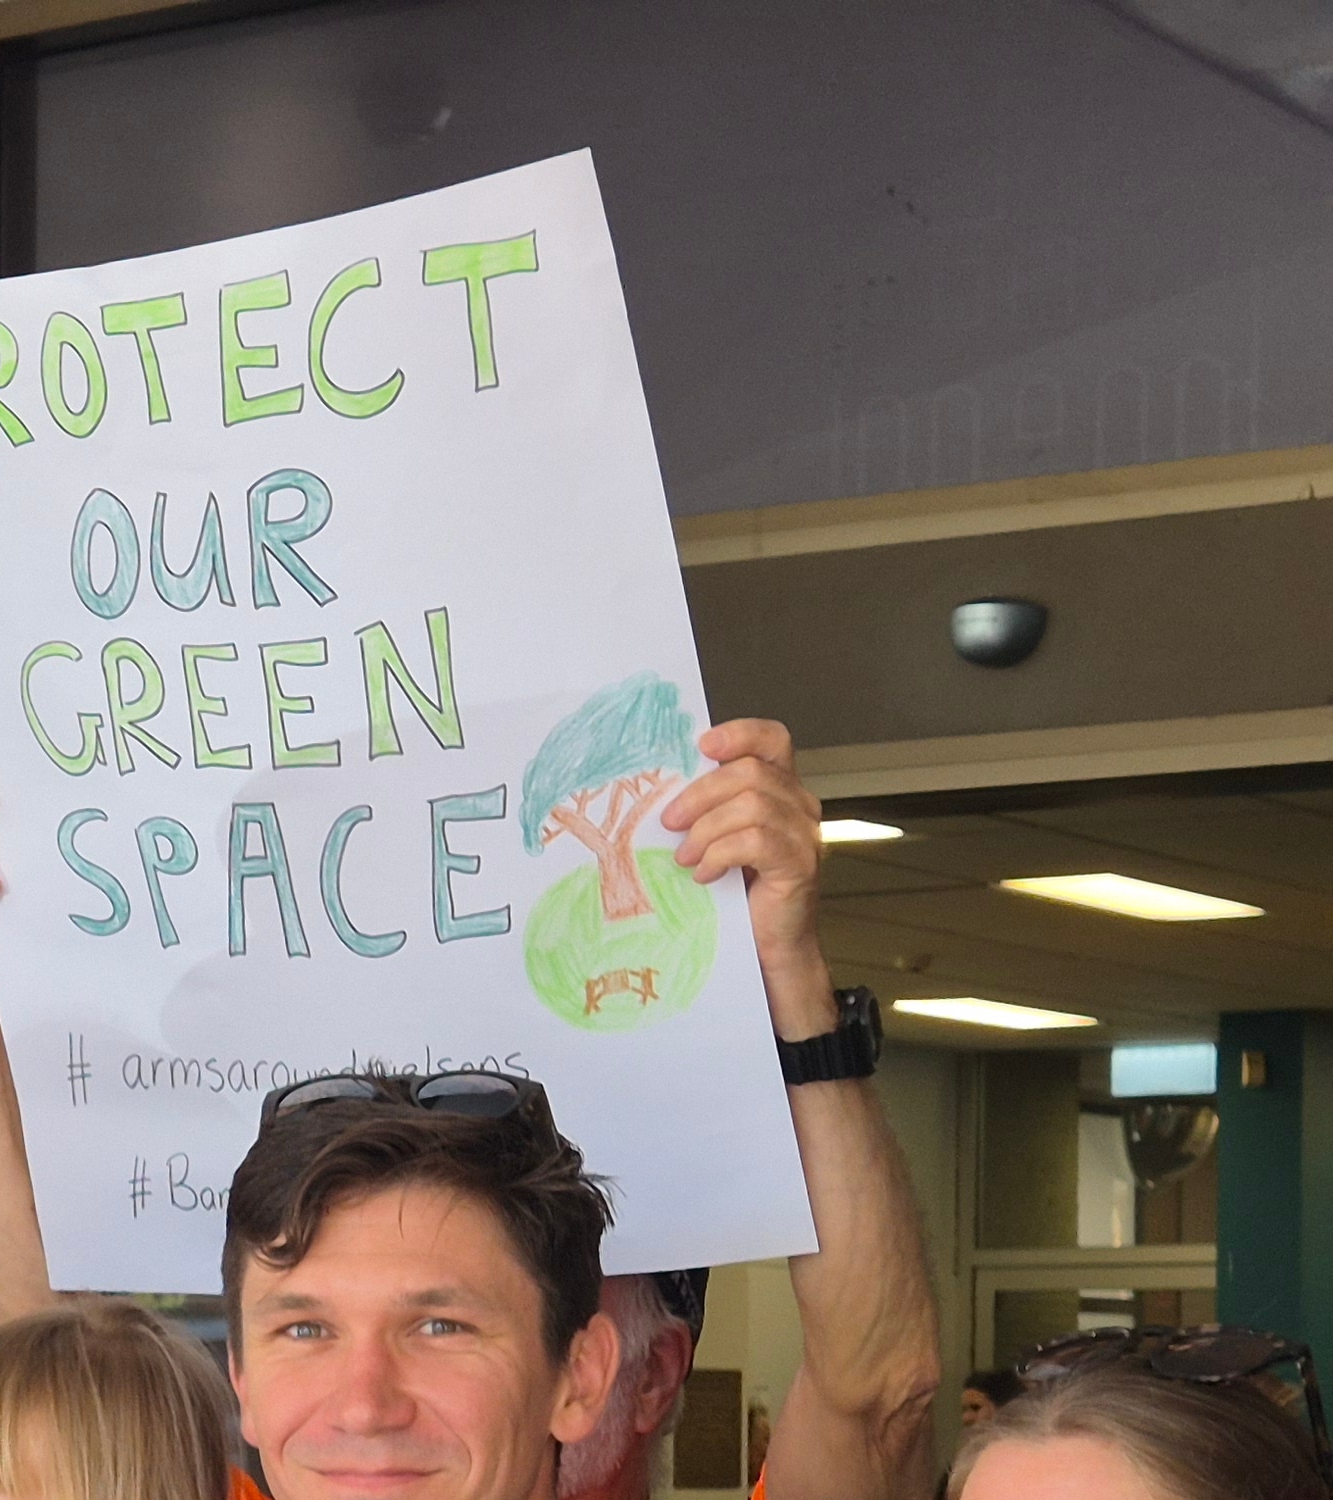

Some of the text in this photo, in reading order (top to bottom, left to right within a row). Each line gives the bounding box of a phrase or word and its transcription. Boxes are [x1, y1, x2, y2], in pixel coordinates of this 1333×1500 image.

[70, 468, 337, 619] OUR
[20, 607, 464, 775] GREEN
[56, 783, 511, 959] SPACE
